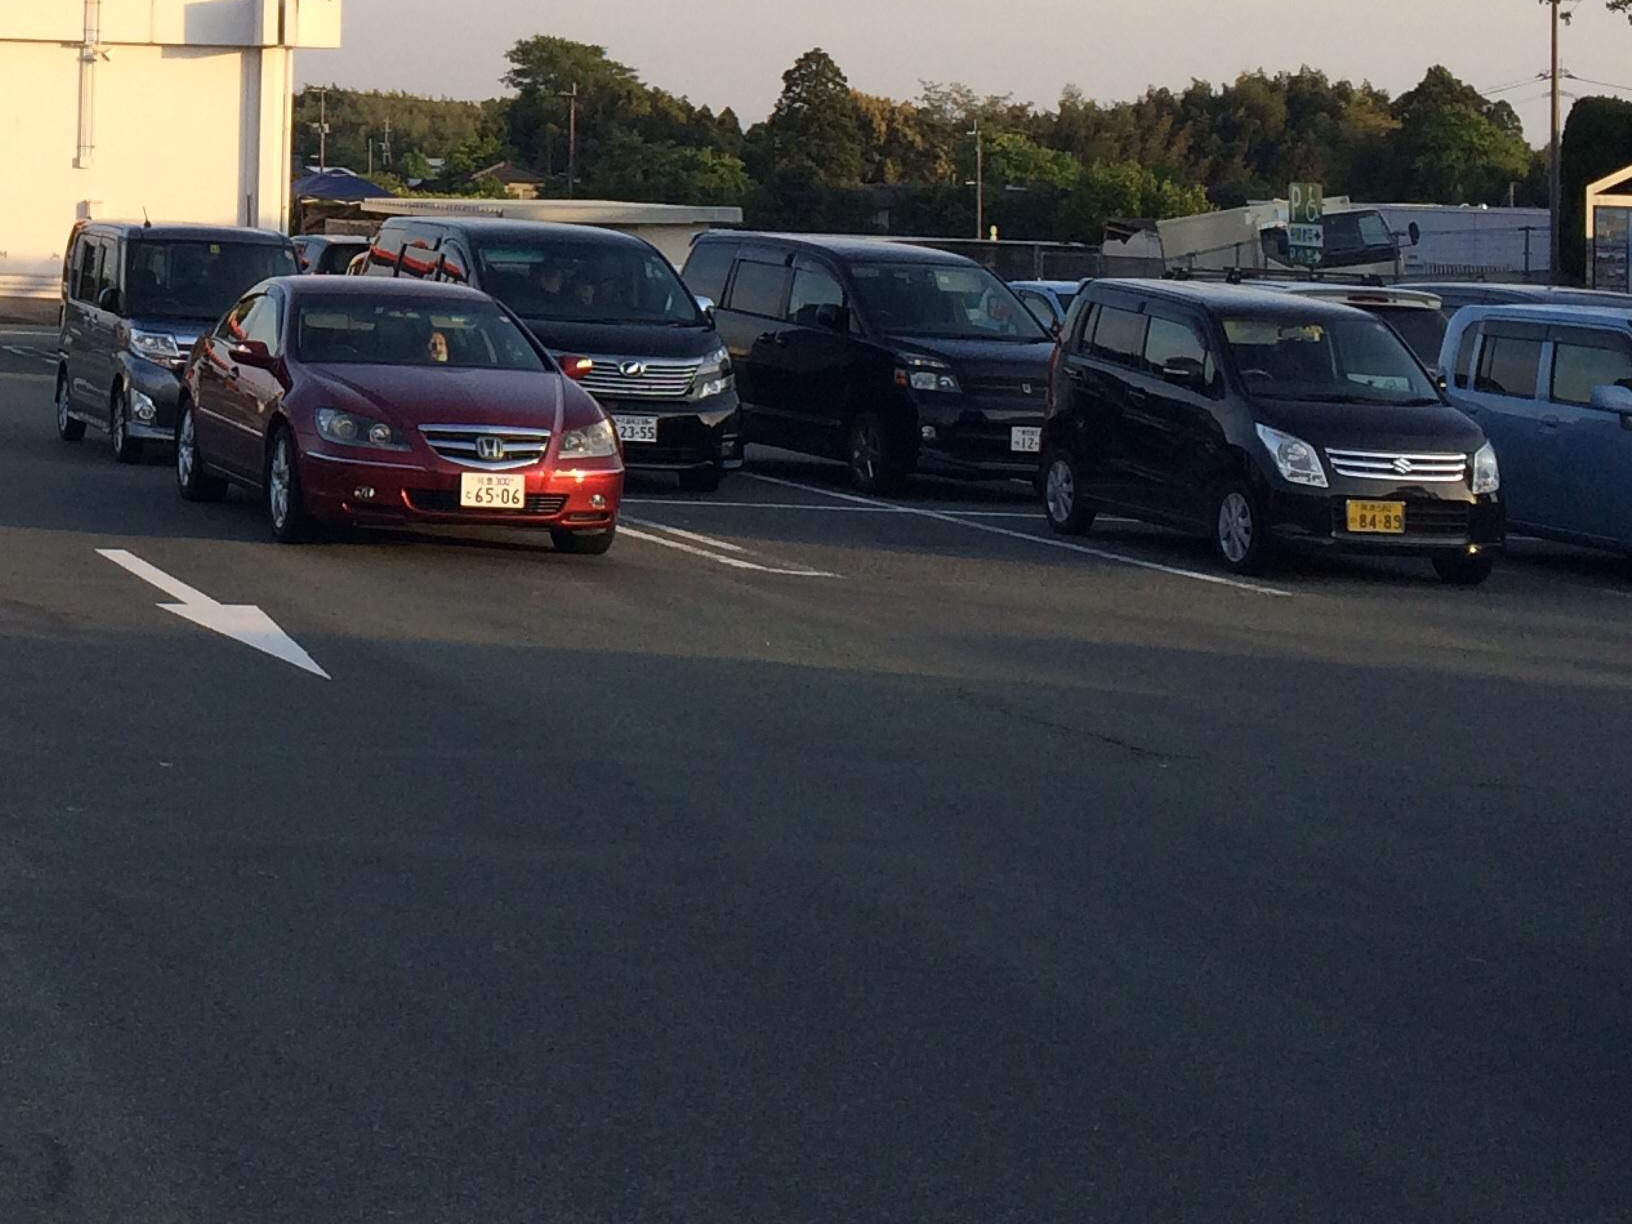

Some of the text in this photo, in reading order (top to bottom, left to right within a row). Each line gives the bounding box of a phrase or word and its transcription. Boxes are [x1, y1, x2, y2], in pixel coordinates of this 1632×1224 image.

[1290, 185, 1301, 222] P
[620, 426, 655, 440] 23-55
[475, 487, 520, 504] 65-06
